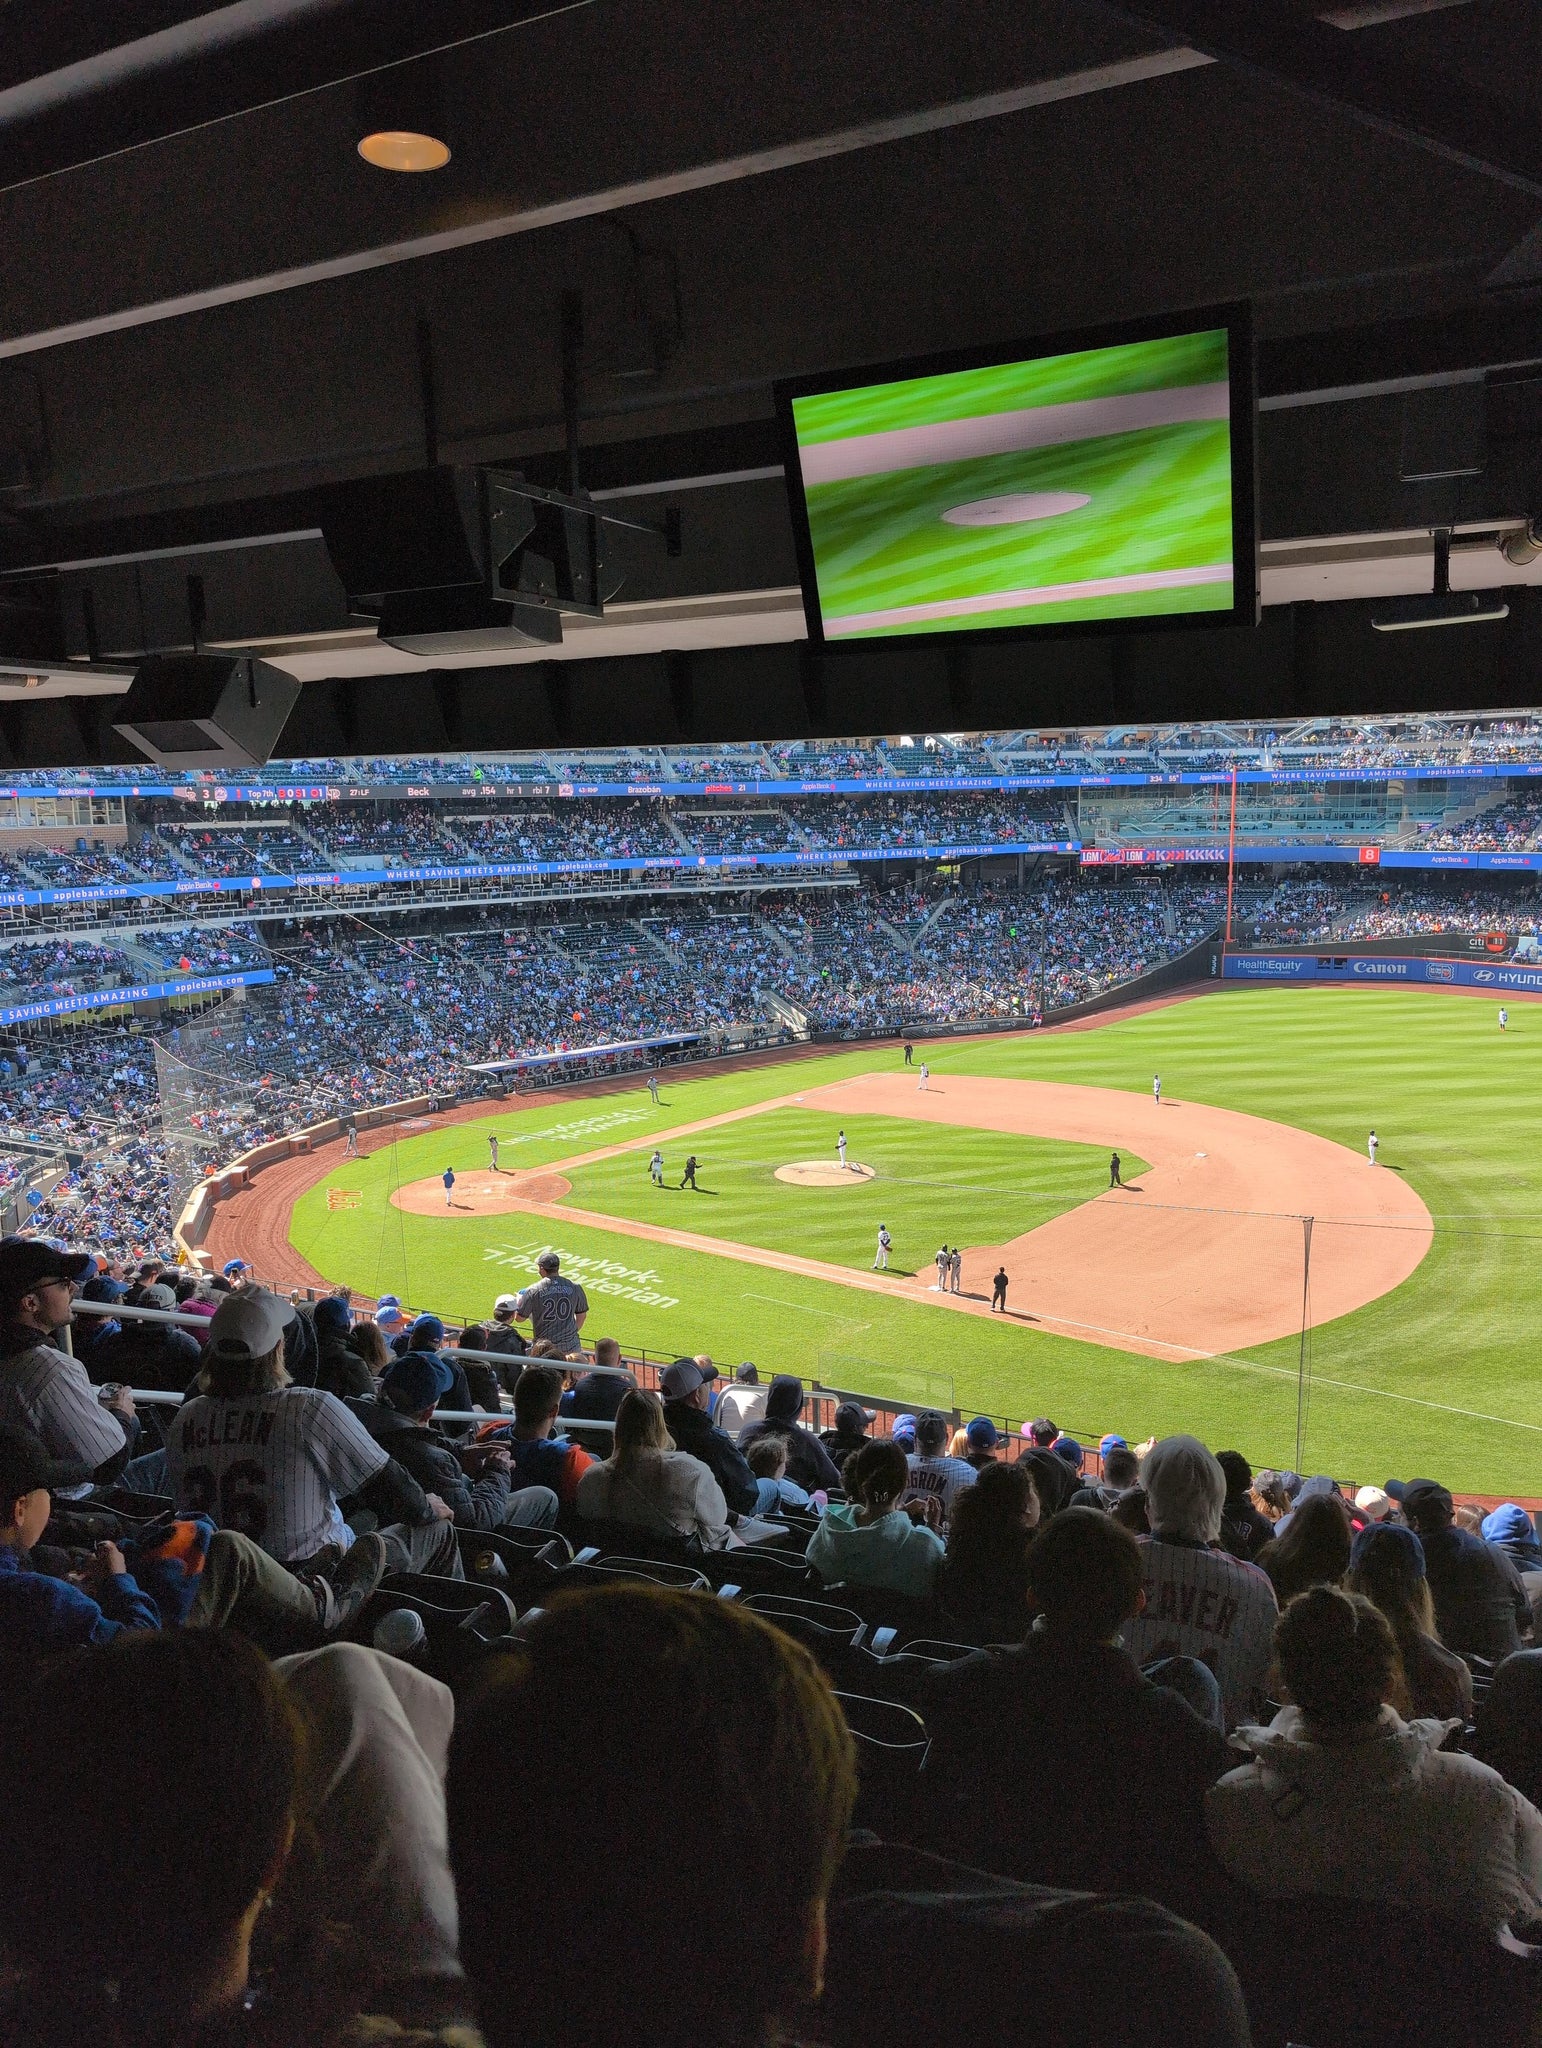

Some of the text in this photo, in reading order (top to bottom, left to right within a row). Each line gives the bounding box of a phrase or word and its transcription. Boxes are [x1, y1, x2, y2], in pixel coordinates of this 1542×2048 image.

[203, 789, 209, 798] 3
[248, 790, 261, 798] Top
[287, 789, 294, 797] 0
[408, 788, 430, 796] Beck
[462, 788, 476, 796] avg
[480, 787, 496, 795] .154
[705, 785, 733, 793] pitches
[796, 853, 824, 861] WHERE
[828, 851, 858, 859] SAVING
[890, 849, 927, 857] AMAZING
[945, 846, 993, 855] applebank.com
[1083, 851, 1099, 861] LGM
[1126, 851, 1142, 860] LGM
[1365, 850, 1374, 859] 8
[1490, 857, 1507, 865] Apple
[386, 862, 608, 879] WHERE SAVING MEETS AMAZING applebank.com
[297, 876, 312, 884] Apple
[176, 882, 194, 891] Apple
[54, 888, 128, 900] applebank.com
[1238, 960, 1302, 971] HealthEquity
[1354, 962, 1407, 974] Canon
[9, 1004, 50, 1020] SAVING
[55, 997, 89, 1011] MEETS
[93, 988, 149, 1003] AMAZING
[175, 975, 244, 992] applebank.com
[496, 1254, 680, 1309] Prebyterian
[541, 1297, 572, 1321] 20
[182, 1409, 276, 1452] McLEAN
[905, 1470, 949, 1495] GROM
[1140, 1578, 1238, 1639] EAVER
